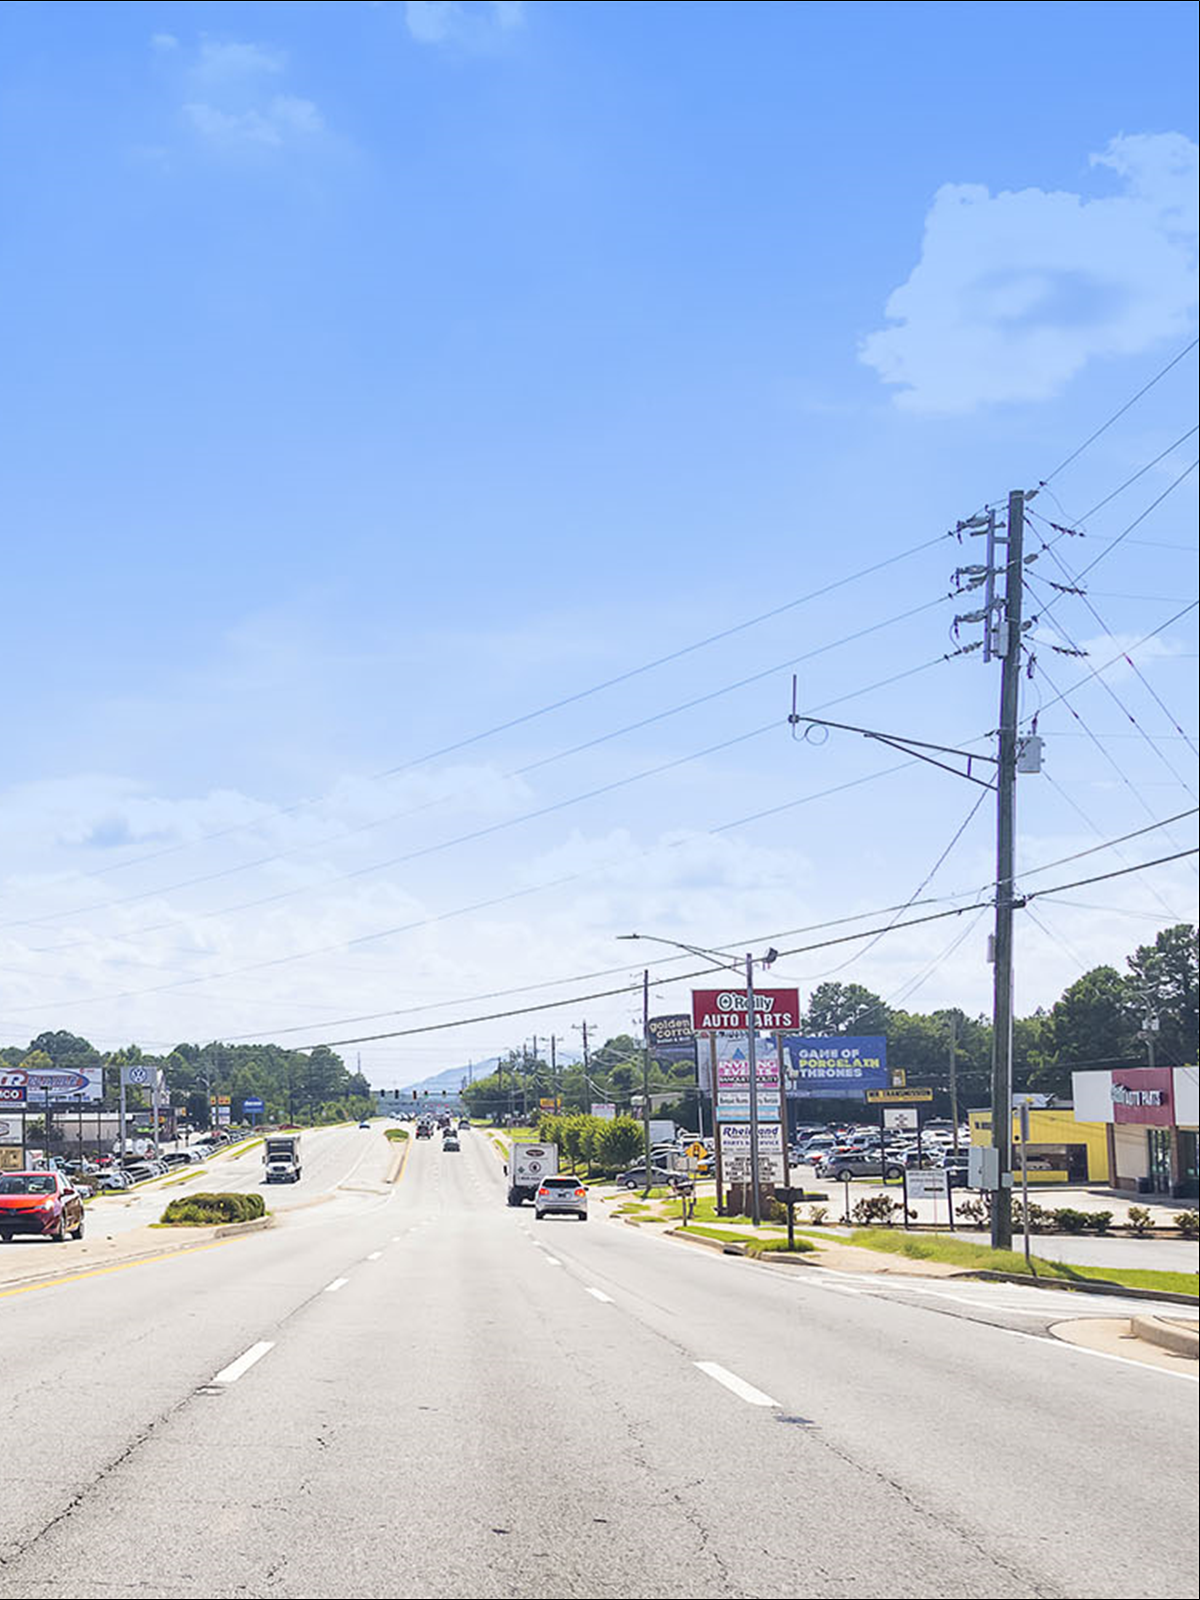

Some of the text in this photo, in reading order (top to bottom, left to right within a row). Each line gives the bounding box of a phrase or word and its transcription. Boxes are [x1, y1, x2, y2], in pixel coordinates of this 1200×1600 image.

[702, 1014, 739, 1027] AUTO
[649, 1020, 690, 1033] golden
[799, 1049, 860, 1059] GAME OF
[799, 1058, 880, 1068] PORCELAIN
[800, 1068, 863, 1078] THRONES
